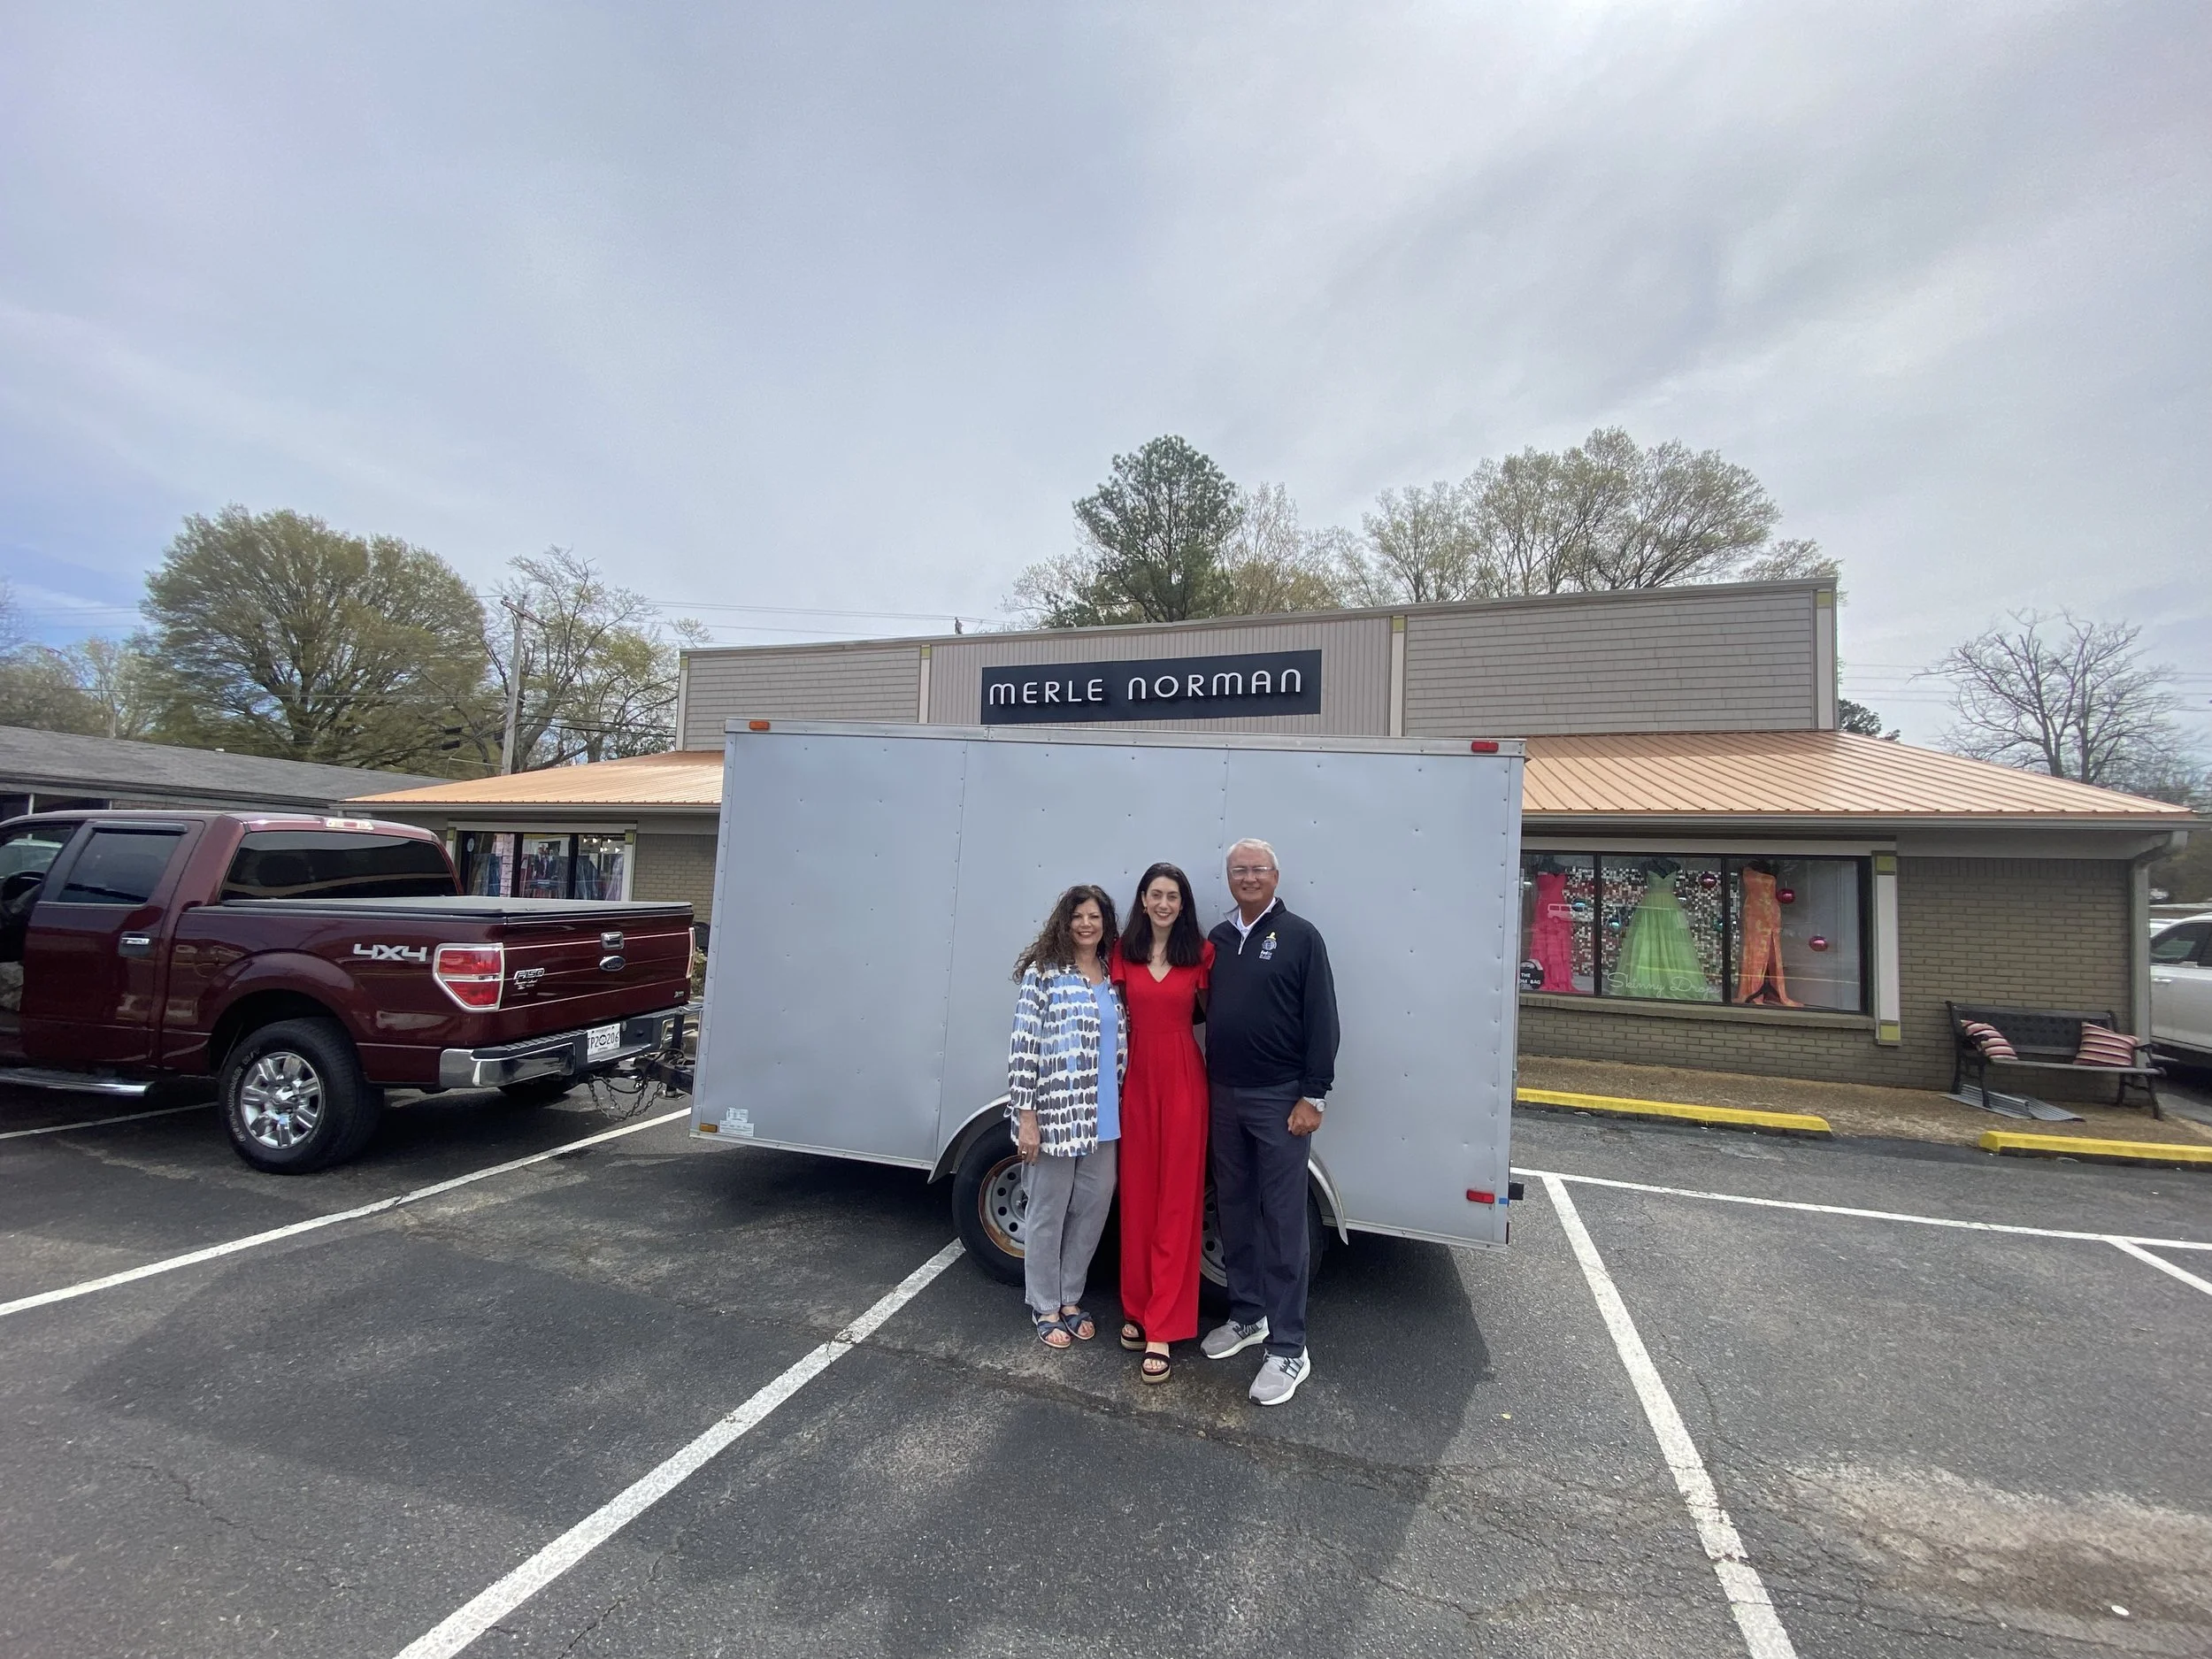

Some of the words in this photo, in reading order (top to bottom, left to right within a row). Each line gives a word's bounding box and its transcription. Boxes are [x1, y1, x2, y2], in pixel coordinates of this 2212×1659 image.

[989, 678, 1103, 705] MERLE
[1127, 668, 1302, 701] NORMAN
[353, 943, 427, 962] 4X4
[1607, 972, 1664, 998] Skinny
